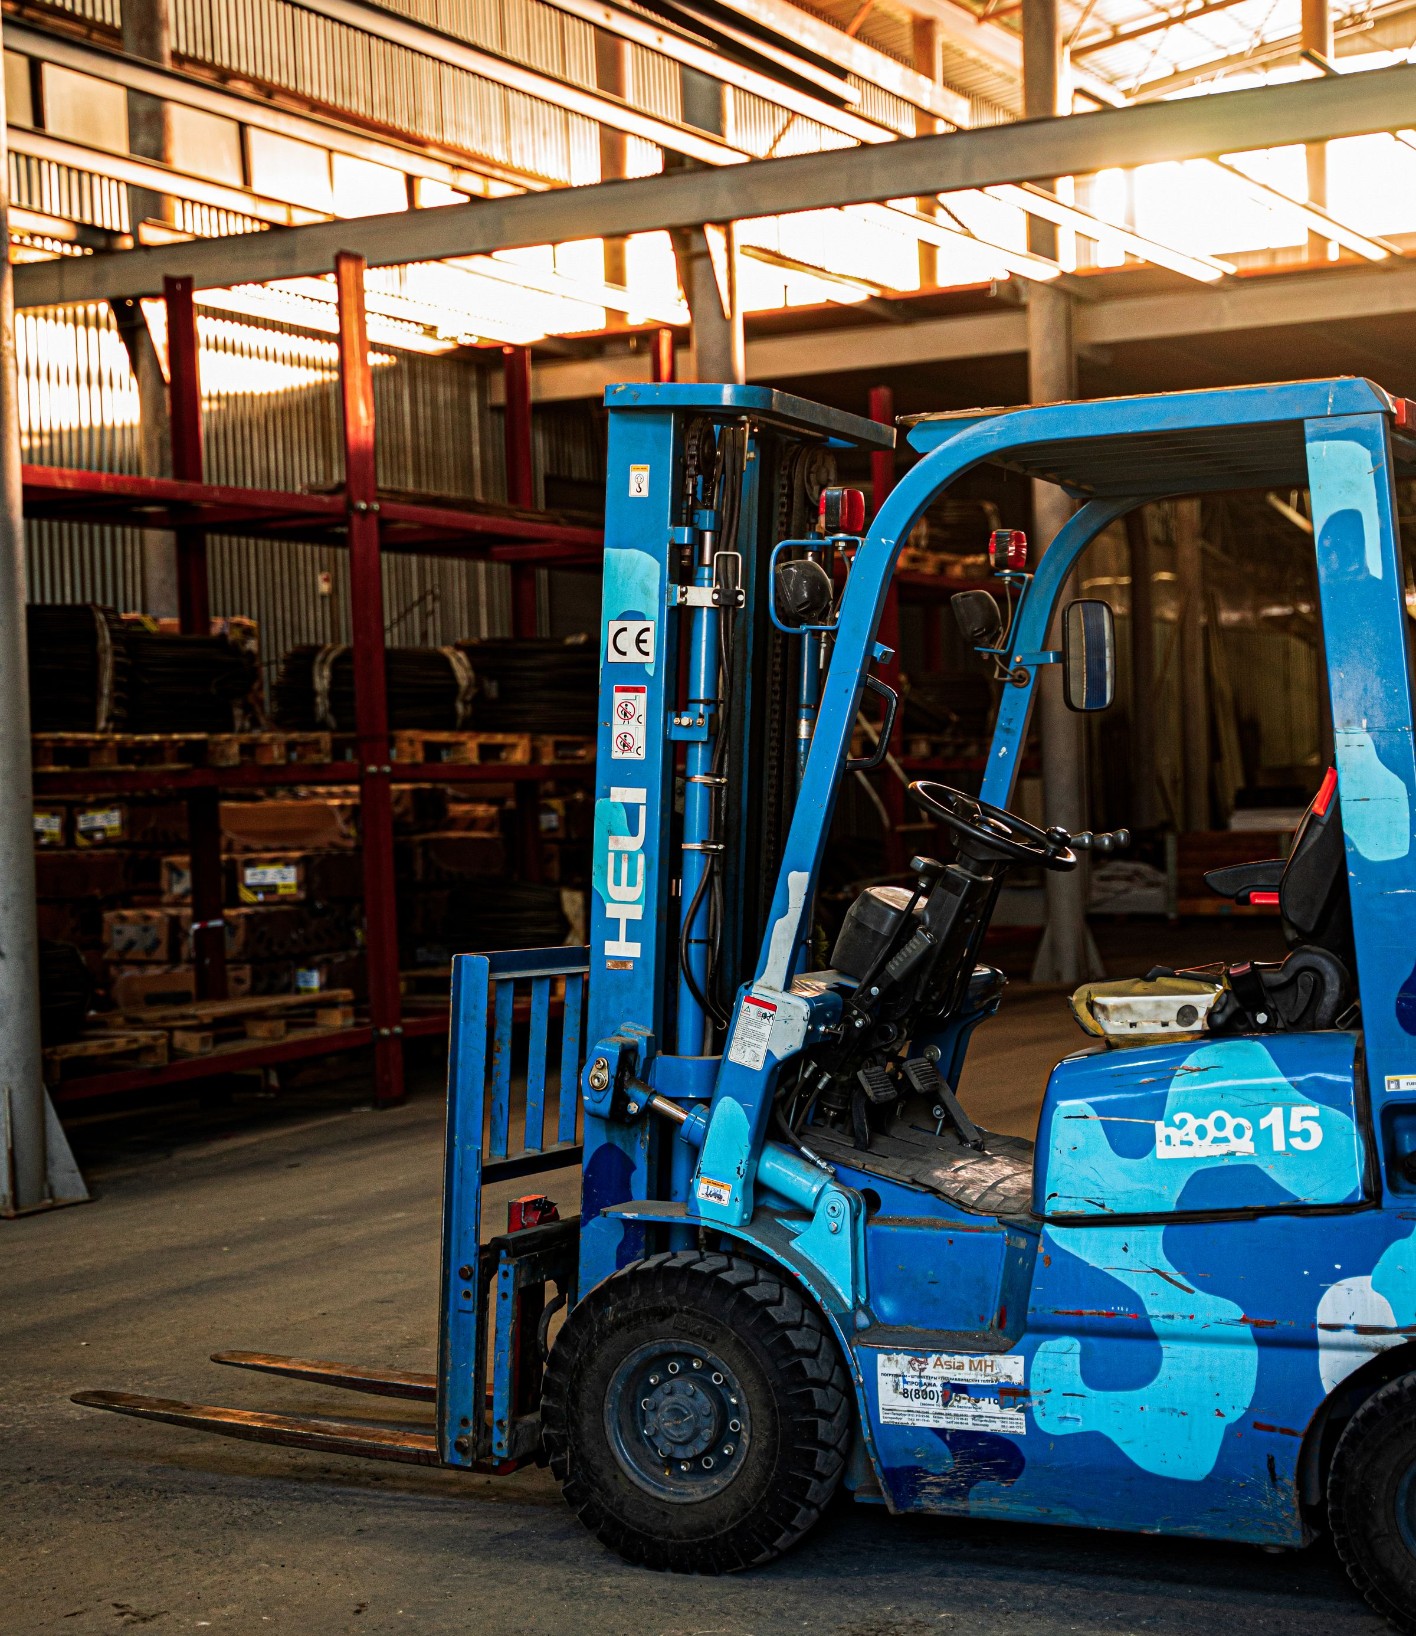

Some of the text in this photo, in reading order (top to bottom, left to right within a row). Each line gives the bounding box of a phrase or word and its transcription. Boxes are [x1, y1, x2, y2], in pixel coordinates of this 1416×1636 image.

[613, 627, 650, 656] CE
[604, 786, 647, 958] HELI
[1259, 1106, 1323, 1151] 15
[933, 1357, 995, 1373] Asia MH
